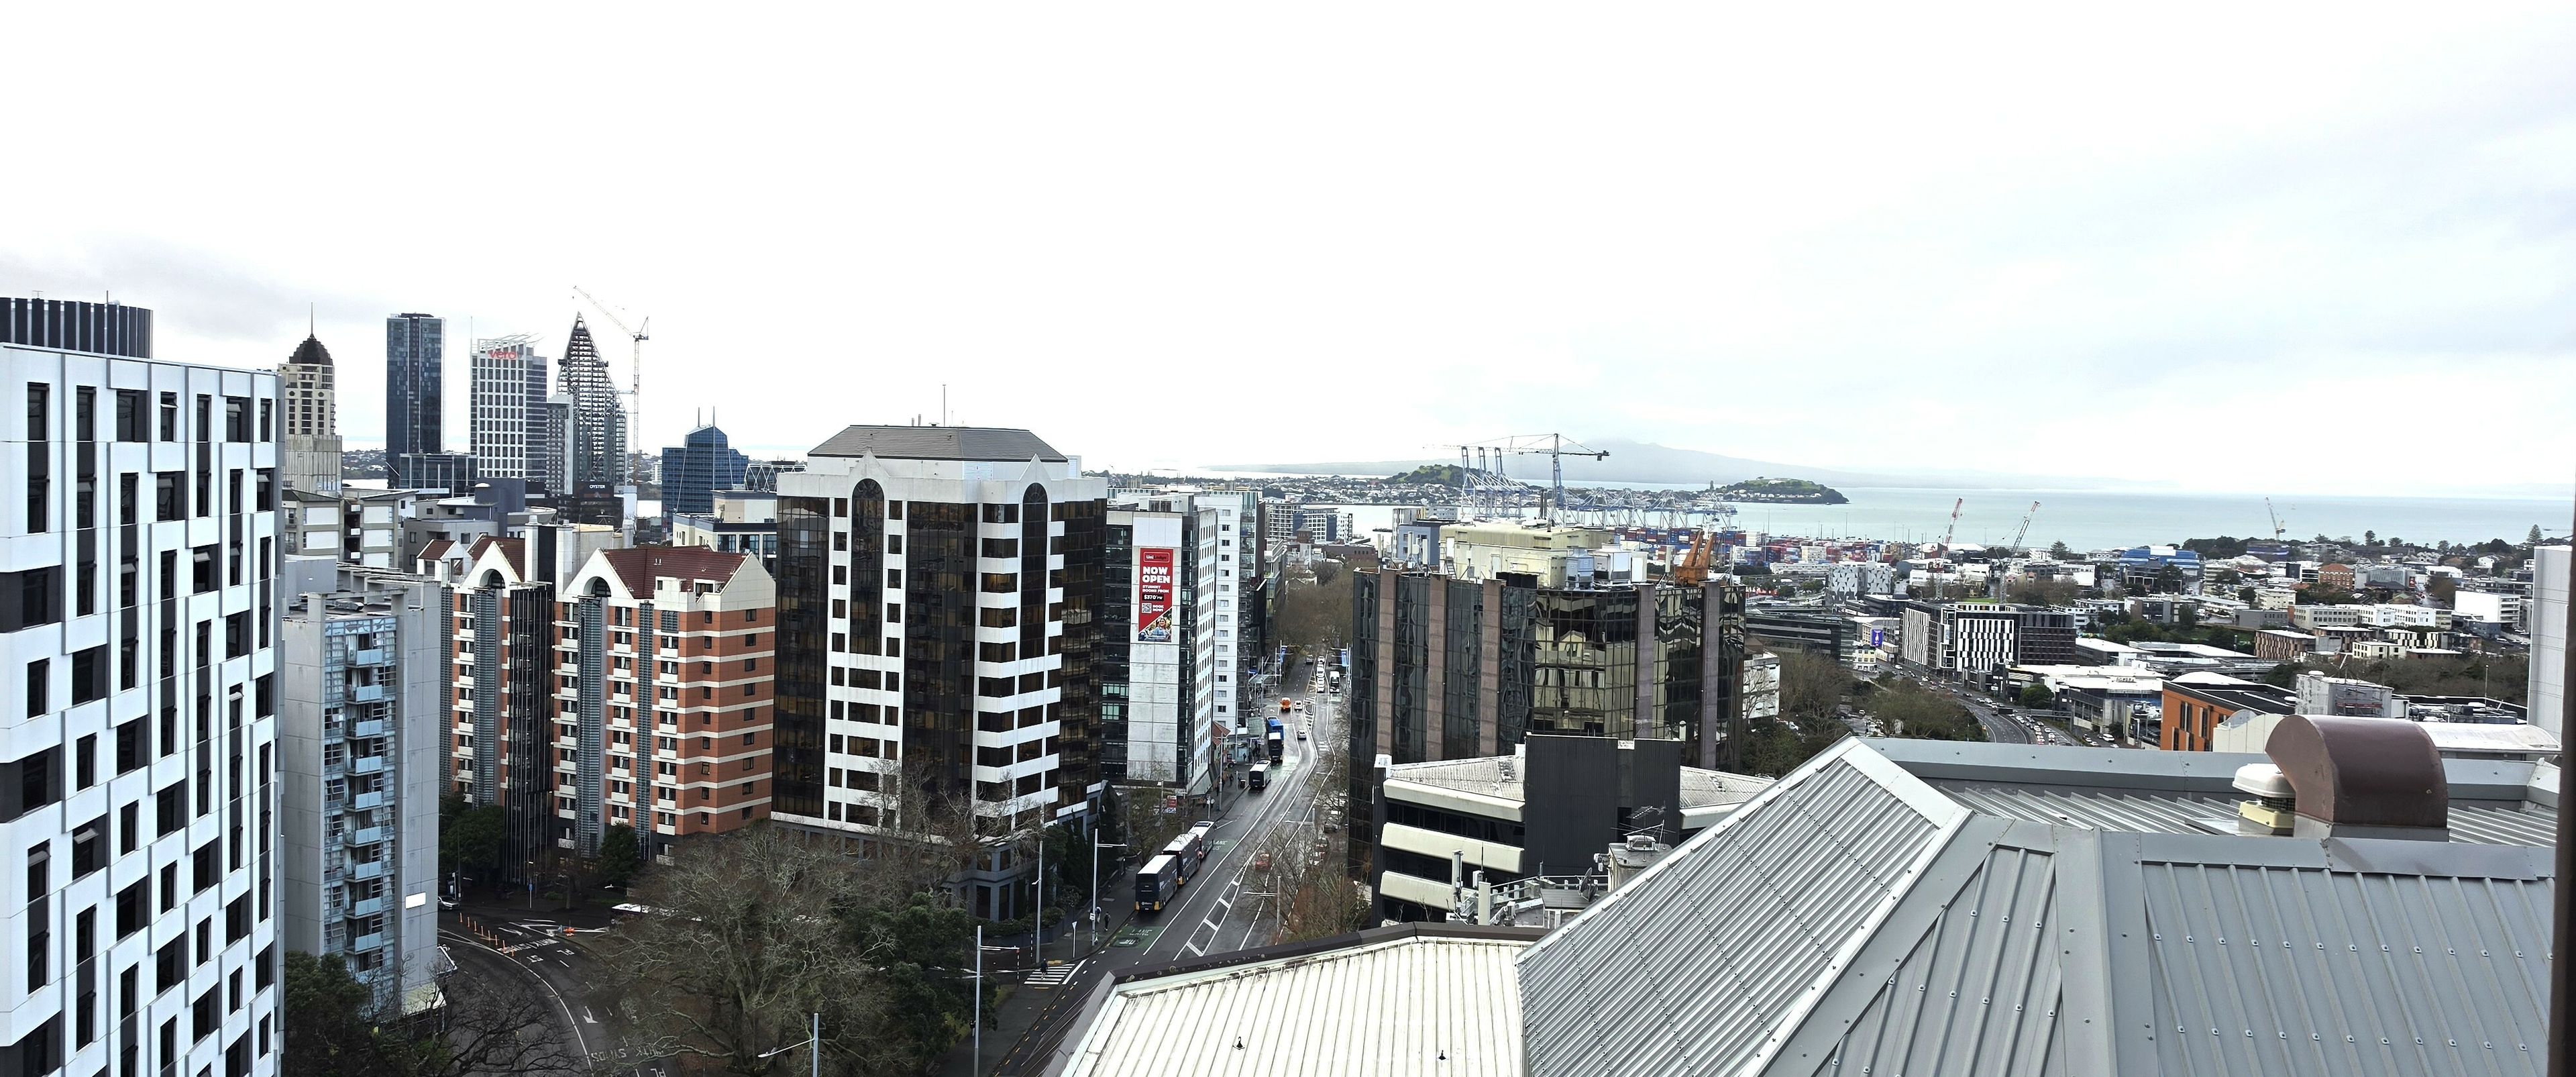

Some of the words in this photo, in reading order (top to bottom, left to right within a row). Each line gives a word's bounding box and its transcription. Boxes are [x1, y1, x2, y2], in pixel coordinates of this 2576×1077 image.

[490, 351, 517, 359] vero
[1143, 566, 1168, 575] NOW
[1142, 574, 1171, 583] OPEN
